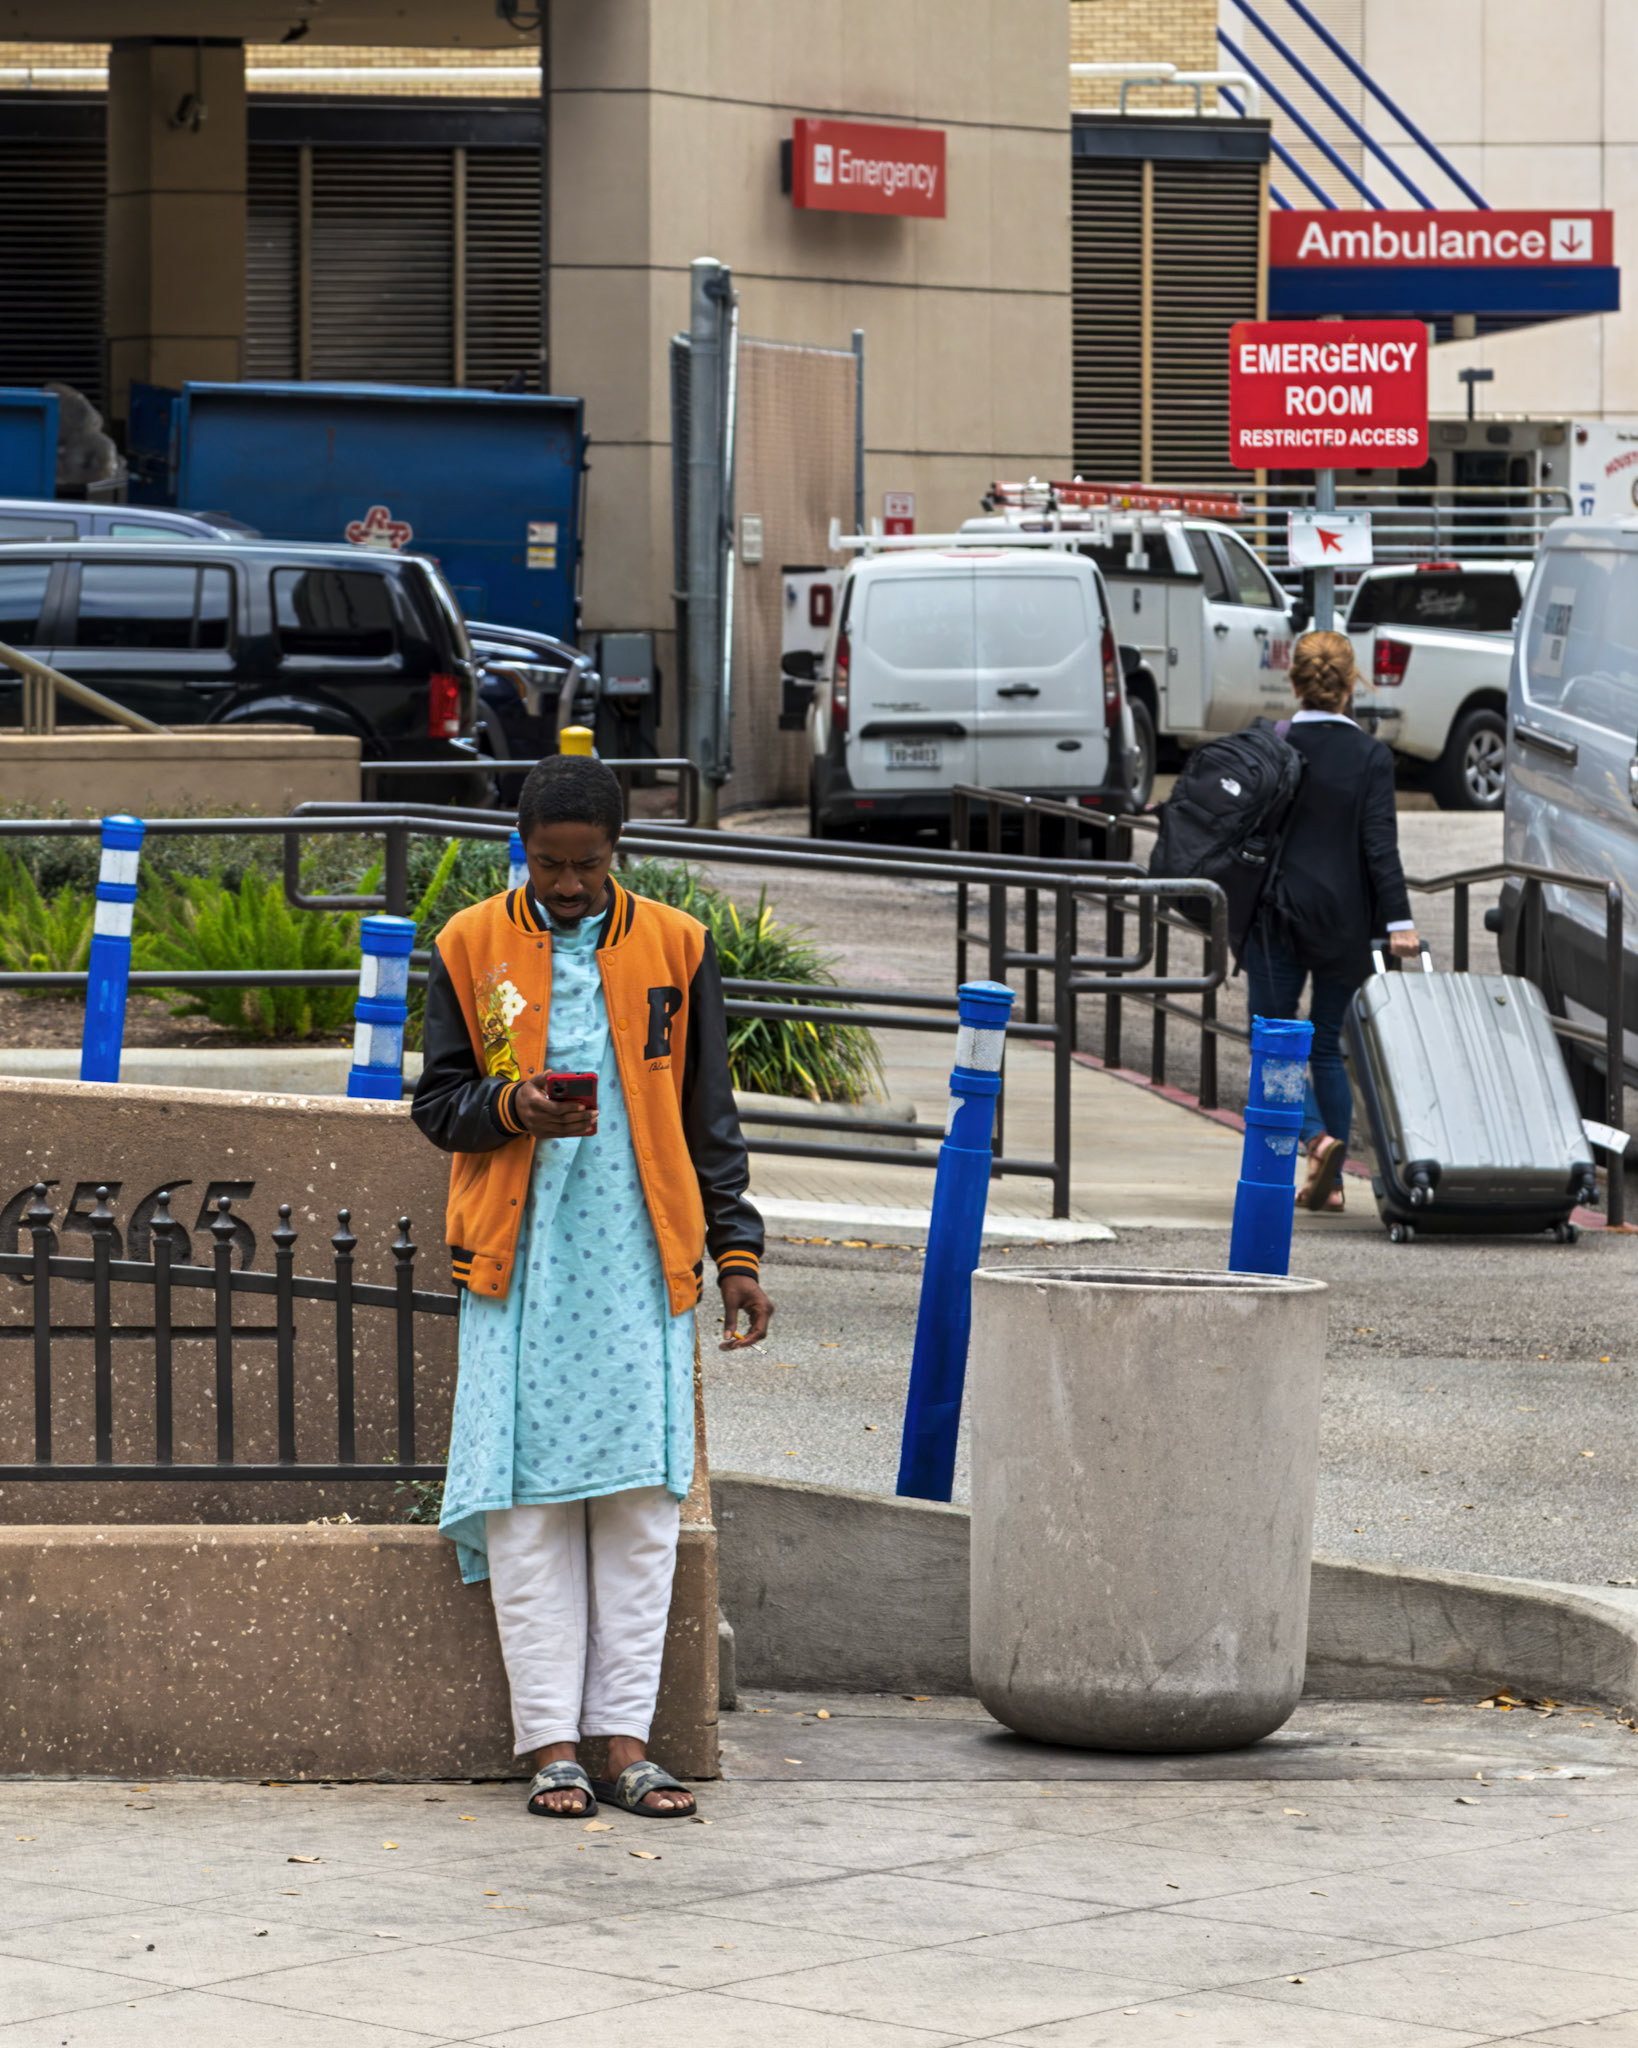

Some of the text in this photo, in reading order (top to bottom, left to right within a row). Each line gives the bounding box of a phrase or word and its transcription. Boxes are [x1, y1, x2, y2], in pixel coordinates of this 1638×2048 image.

[838, 148, 937, 199] Emergency
[1297, 221, 1546, 259] Ambulance
[1239, 343, 1417, 374] EMERGENCY
[1285, 385, 1373, 416] ROOM
[1239, 428, 1419, 447] RESTRICTED ACCESS
[643, 986, 683, 1060] B
[0, 1180, 256, 1287] 6565
